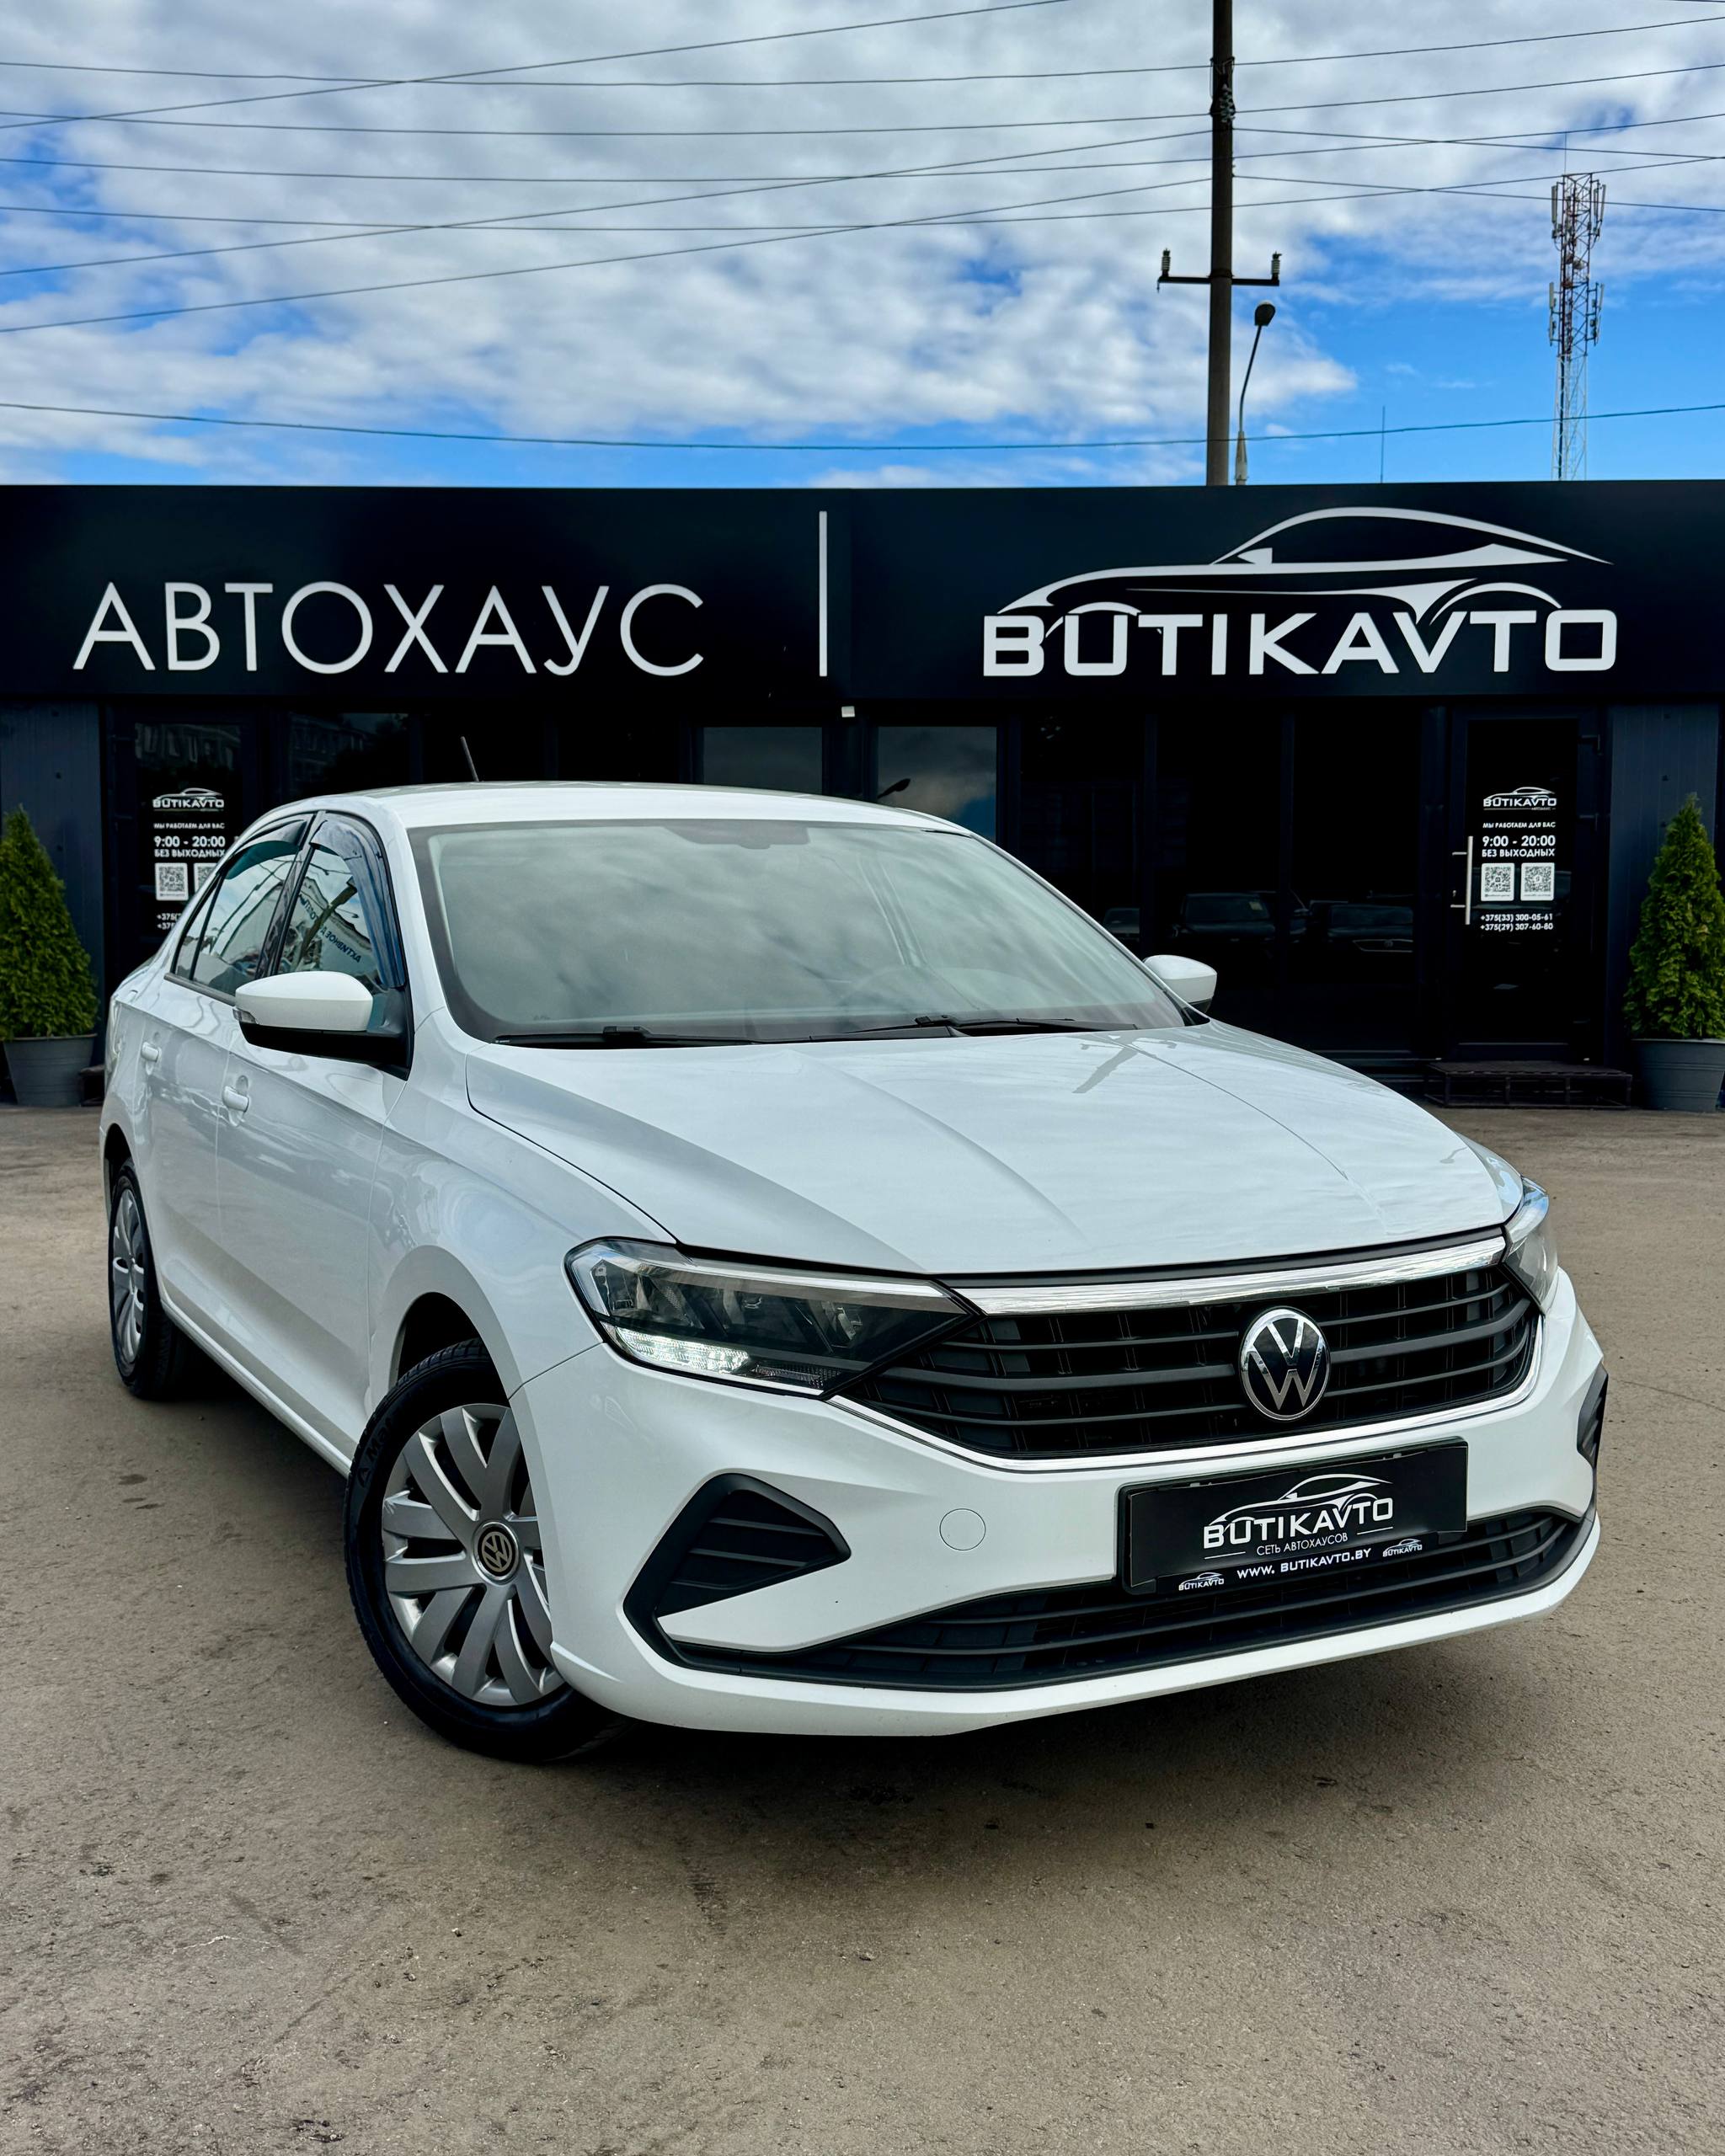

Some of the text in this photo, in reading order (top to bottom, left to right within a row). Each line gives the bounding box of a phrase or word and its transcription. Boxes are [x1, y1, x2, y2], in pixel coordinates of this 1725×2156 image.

[72, 581, 704, 675] АВТОХАУС
[983, 608, 1617, 675] BUTIKAVTO
[152, 798, 225, 808] BUTIKAVTO
[1482, 798, 1557, 807] BUTIKAVTO
[153, 835, 180, 847] 9:00
[191, 835, 226, 847] 20:00
[1482, 835, 1509, 846] 9:00
[1520, 835, 1556, 846] 20:00
[154, 848, 225, 858] БЕЗ ВЫХОДНЫХ
[1482, 848, 1556, 857] БЕЗ ВЫХОДНЫХ
[1481, 913, 1553, 922] +375(33) 300-05-61
[1481, 922, 1554, 932] +375(29) 307-60-80
[1203, 1497, 1393, 1550] BUTIKAVTO
[1256, 1532, 1348, 1556] СЕТЬ АВТОХАУСОВ
[1382, 1544, 1423, 1557] BUTIKAVTO
[1236, 1547, 1372, 1579] WWW. BUTIKAVTO.BY
[1178, 1578, 1225, 1591] BUTIKAVTO
